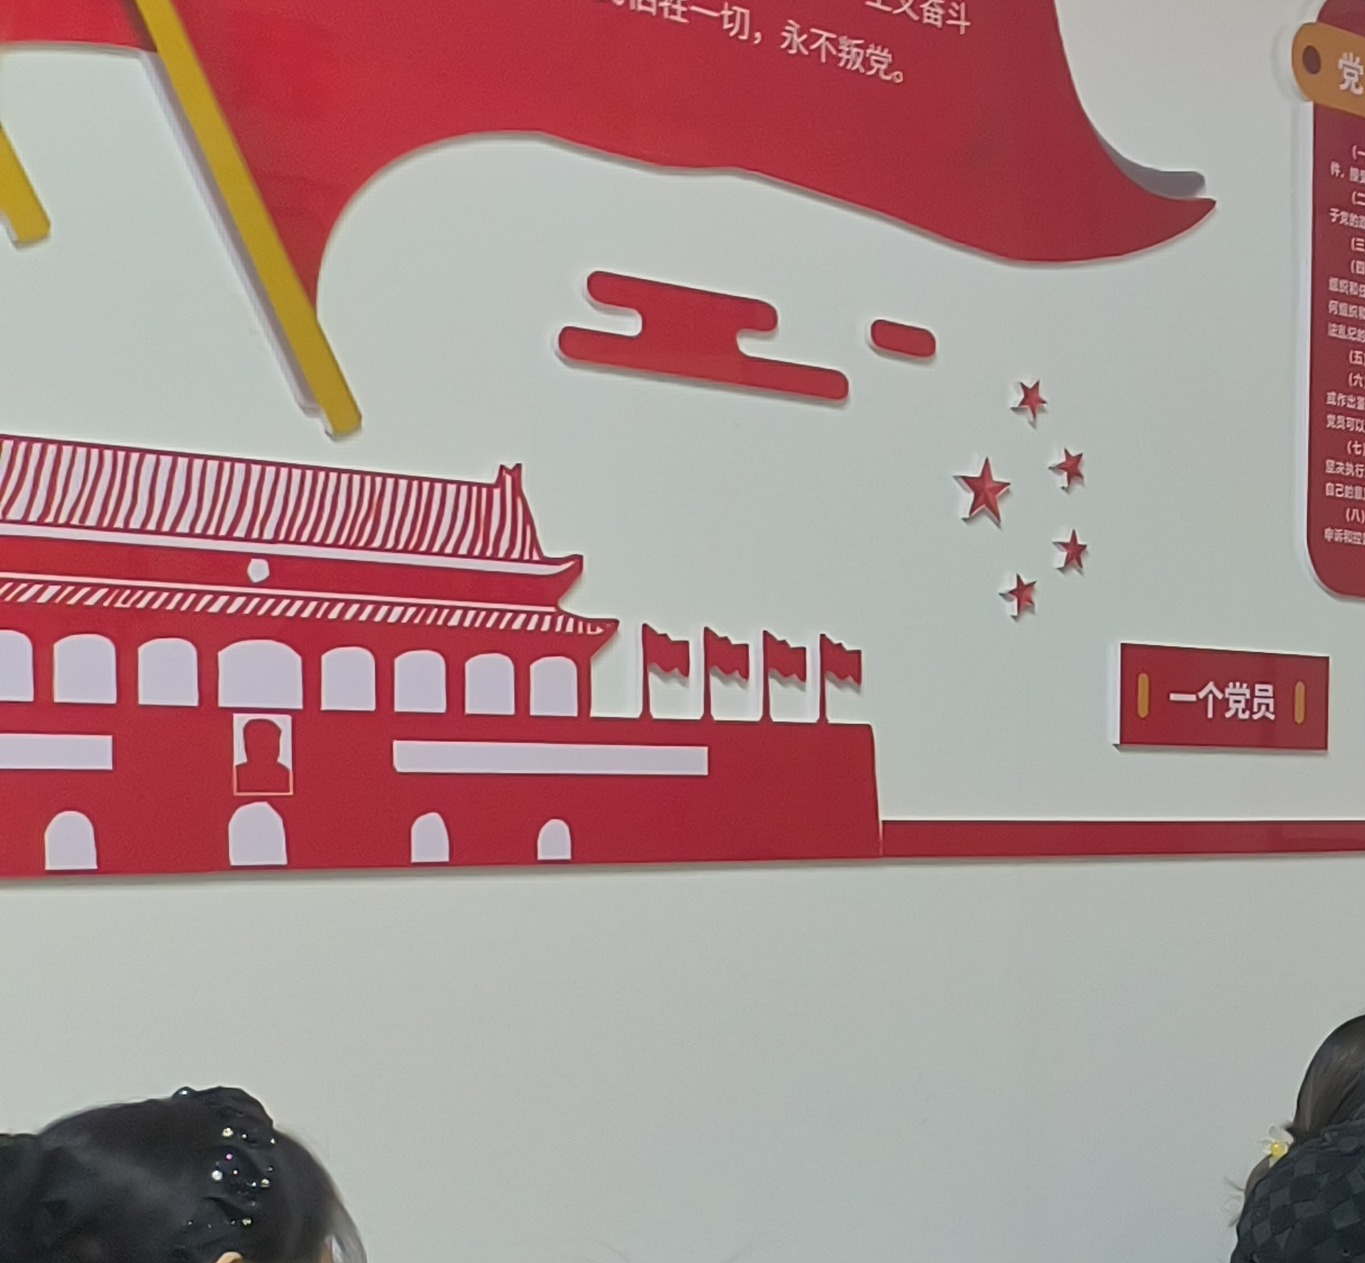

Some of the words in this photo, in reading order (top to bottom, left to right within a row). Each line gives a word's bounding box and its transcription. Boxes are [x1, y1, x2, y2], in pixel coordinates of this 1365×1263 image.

[612, 0, 905, 84] 牲一切，永不叛党。
[1169, 681, 1276, 722] 一个党员
